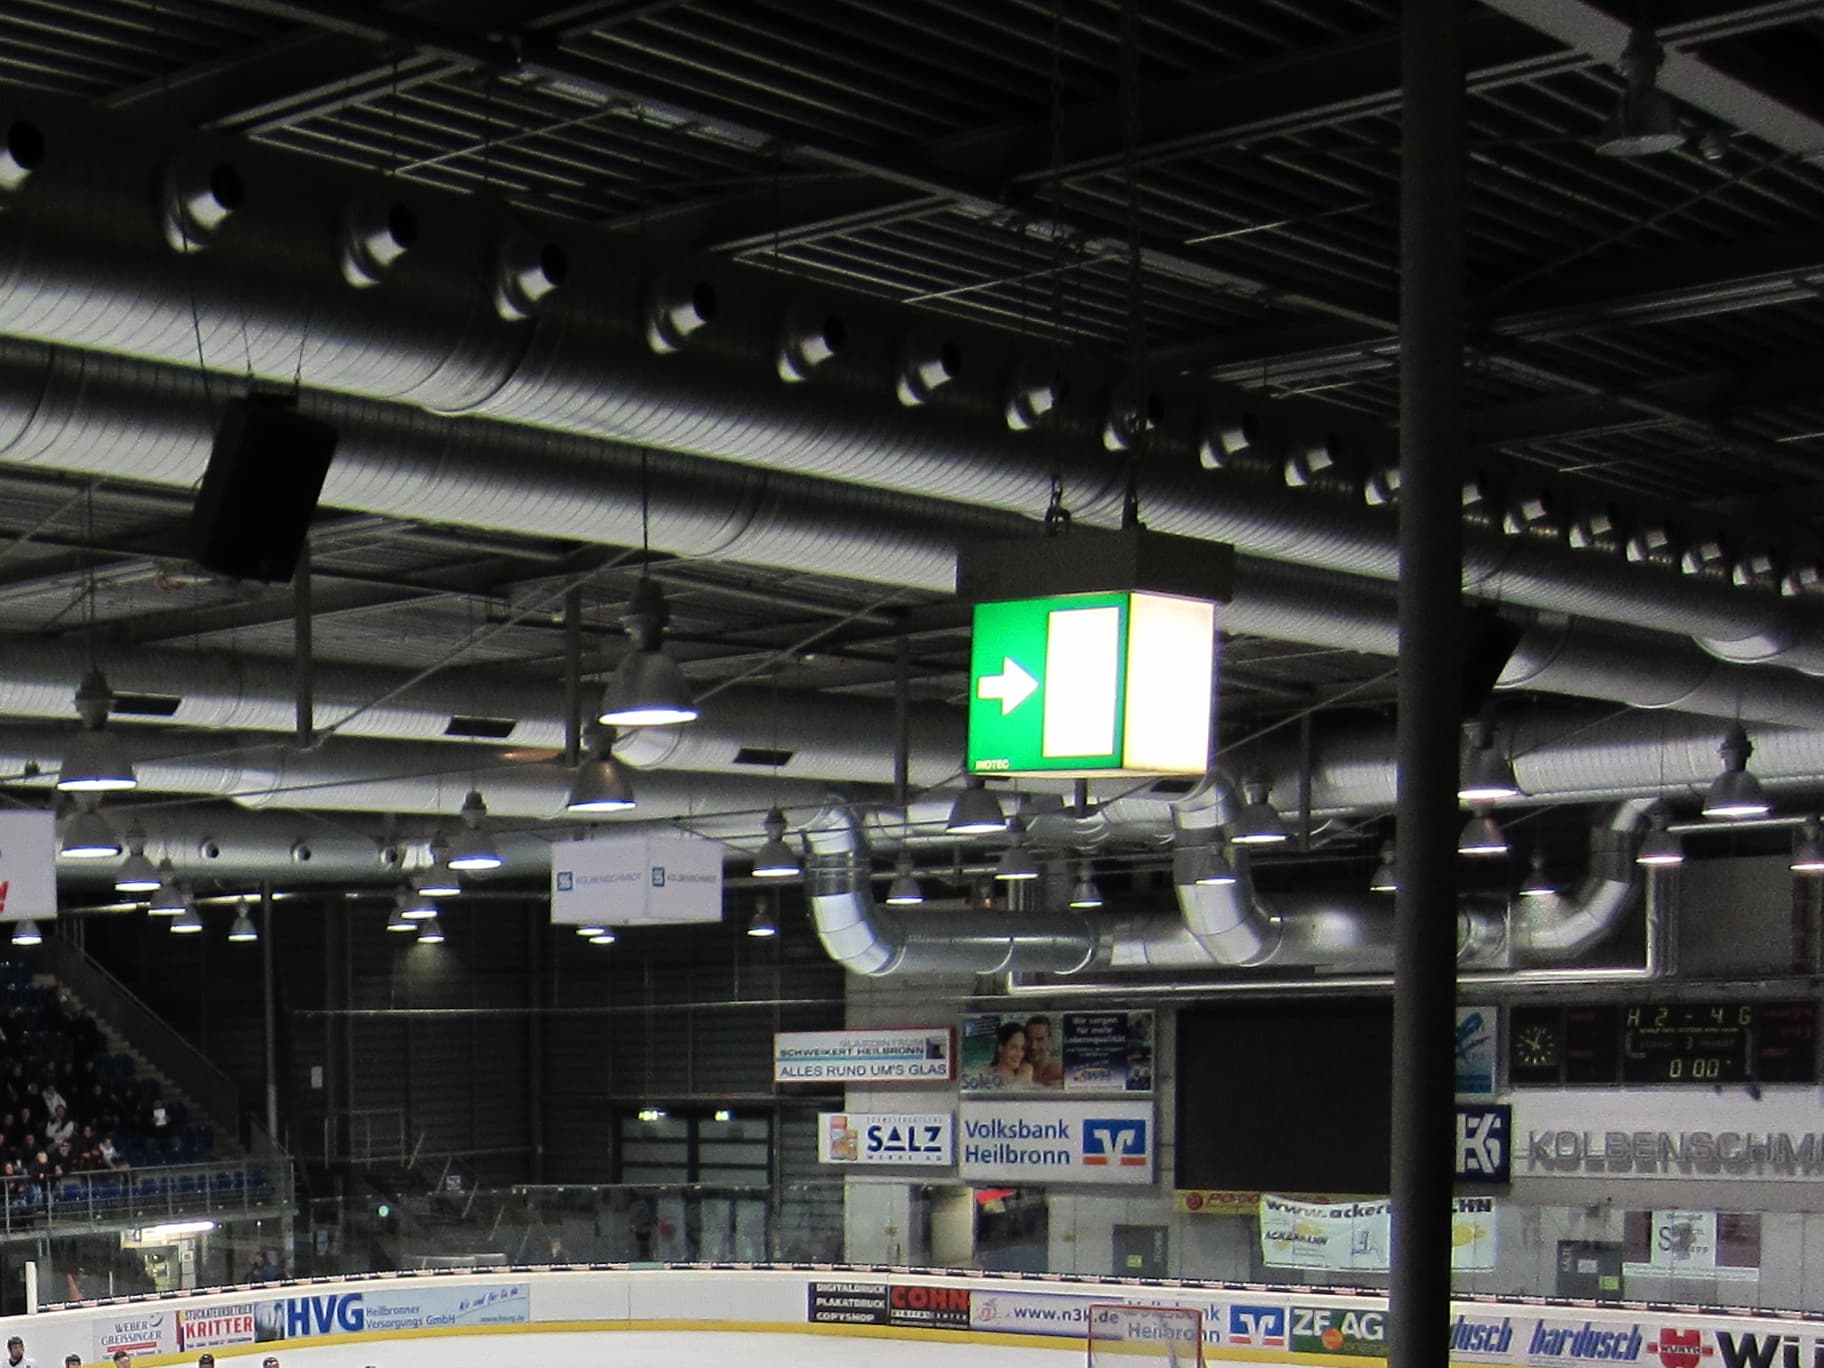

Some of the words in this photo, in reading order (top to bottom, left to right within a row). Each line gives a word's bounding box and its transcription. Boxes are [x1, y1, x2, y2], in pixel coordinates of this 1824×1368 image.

[1655, 1007, 1669, 1026] 2
[1711, 1007, 1724, 1024] 4
[779, 1048, 853, 1057] SCHWEIKERT
[856, 1046, 924, 1056] HEILBRONN
[779, 1065, 823, 1077] ALLES
[826, 1065, 866, 1077] RUND
[908, 1063, 947, 1075] GLAS
[867, 1125, 942, 1152] SALZ
[964, 1119, 1070, 1140] Volksbank
[964, 1144, 1070, 1165] Heilbronn
[816, 1282, 886, 1295] DIGITALDRUCK
[891, 1286, 969, 1311] COHN
[365, 1304, 421, 1317] Heilbronner
[816, 1297, 886, 1310] PLAKATDRUCK
[1013, 1303, 1120, 1324] www.n3k.de
[287, 1293, 364, 1337] HVG
[425, 1314, 456, 1326] GmbH
[816, 1311, 875, 1322] COPYSHOP
[114, 1321, 148, 1334] WEBER
[185, 1315, 253, 1340] KRITTER
[1340, 1312, 1384, 1340] AG
[1449, 1315, 1512, 1353] dusch
[100, 1330, 163, 1347] GREISSINGER
[1528, 1318, 1643, 1362] bardusch
